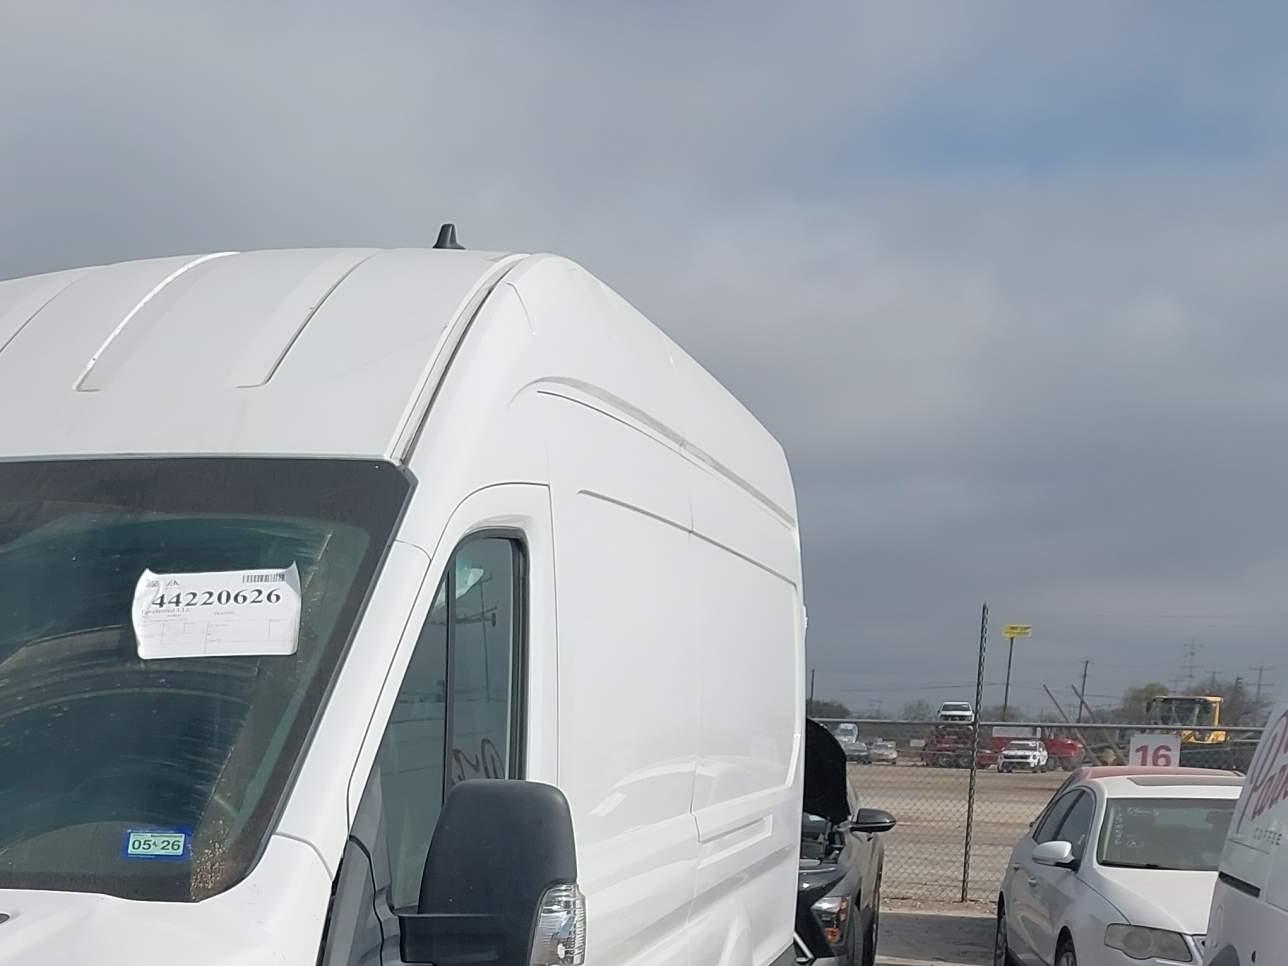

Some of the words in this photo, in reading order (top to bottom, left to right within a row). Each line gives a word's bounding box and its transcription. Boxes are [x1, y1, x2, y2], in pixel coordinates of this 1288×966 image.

[151, 588, 281, 609] 44220626
[1135, 744, 1172, 767] 16
[132, 839, 152, 851] 05
[161, 840, 181, 851] 26
